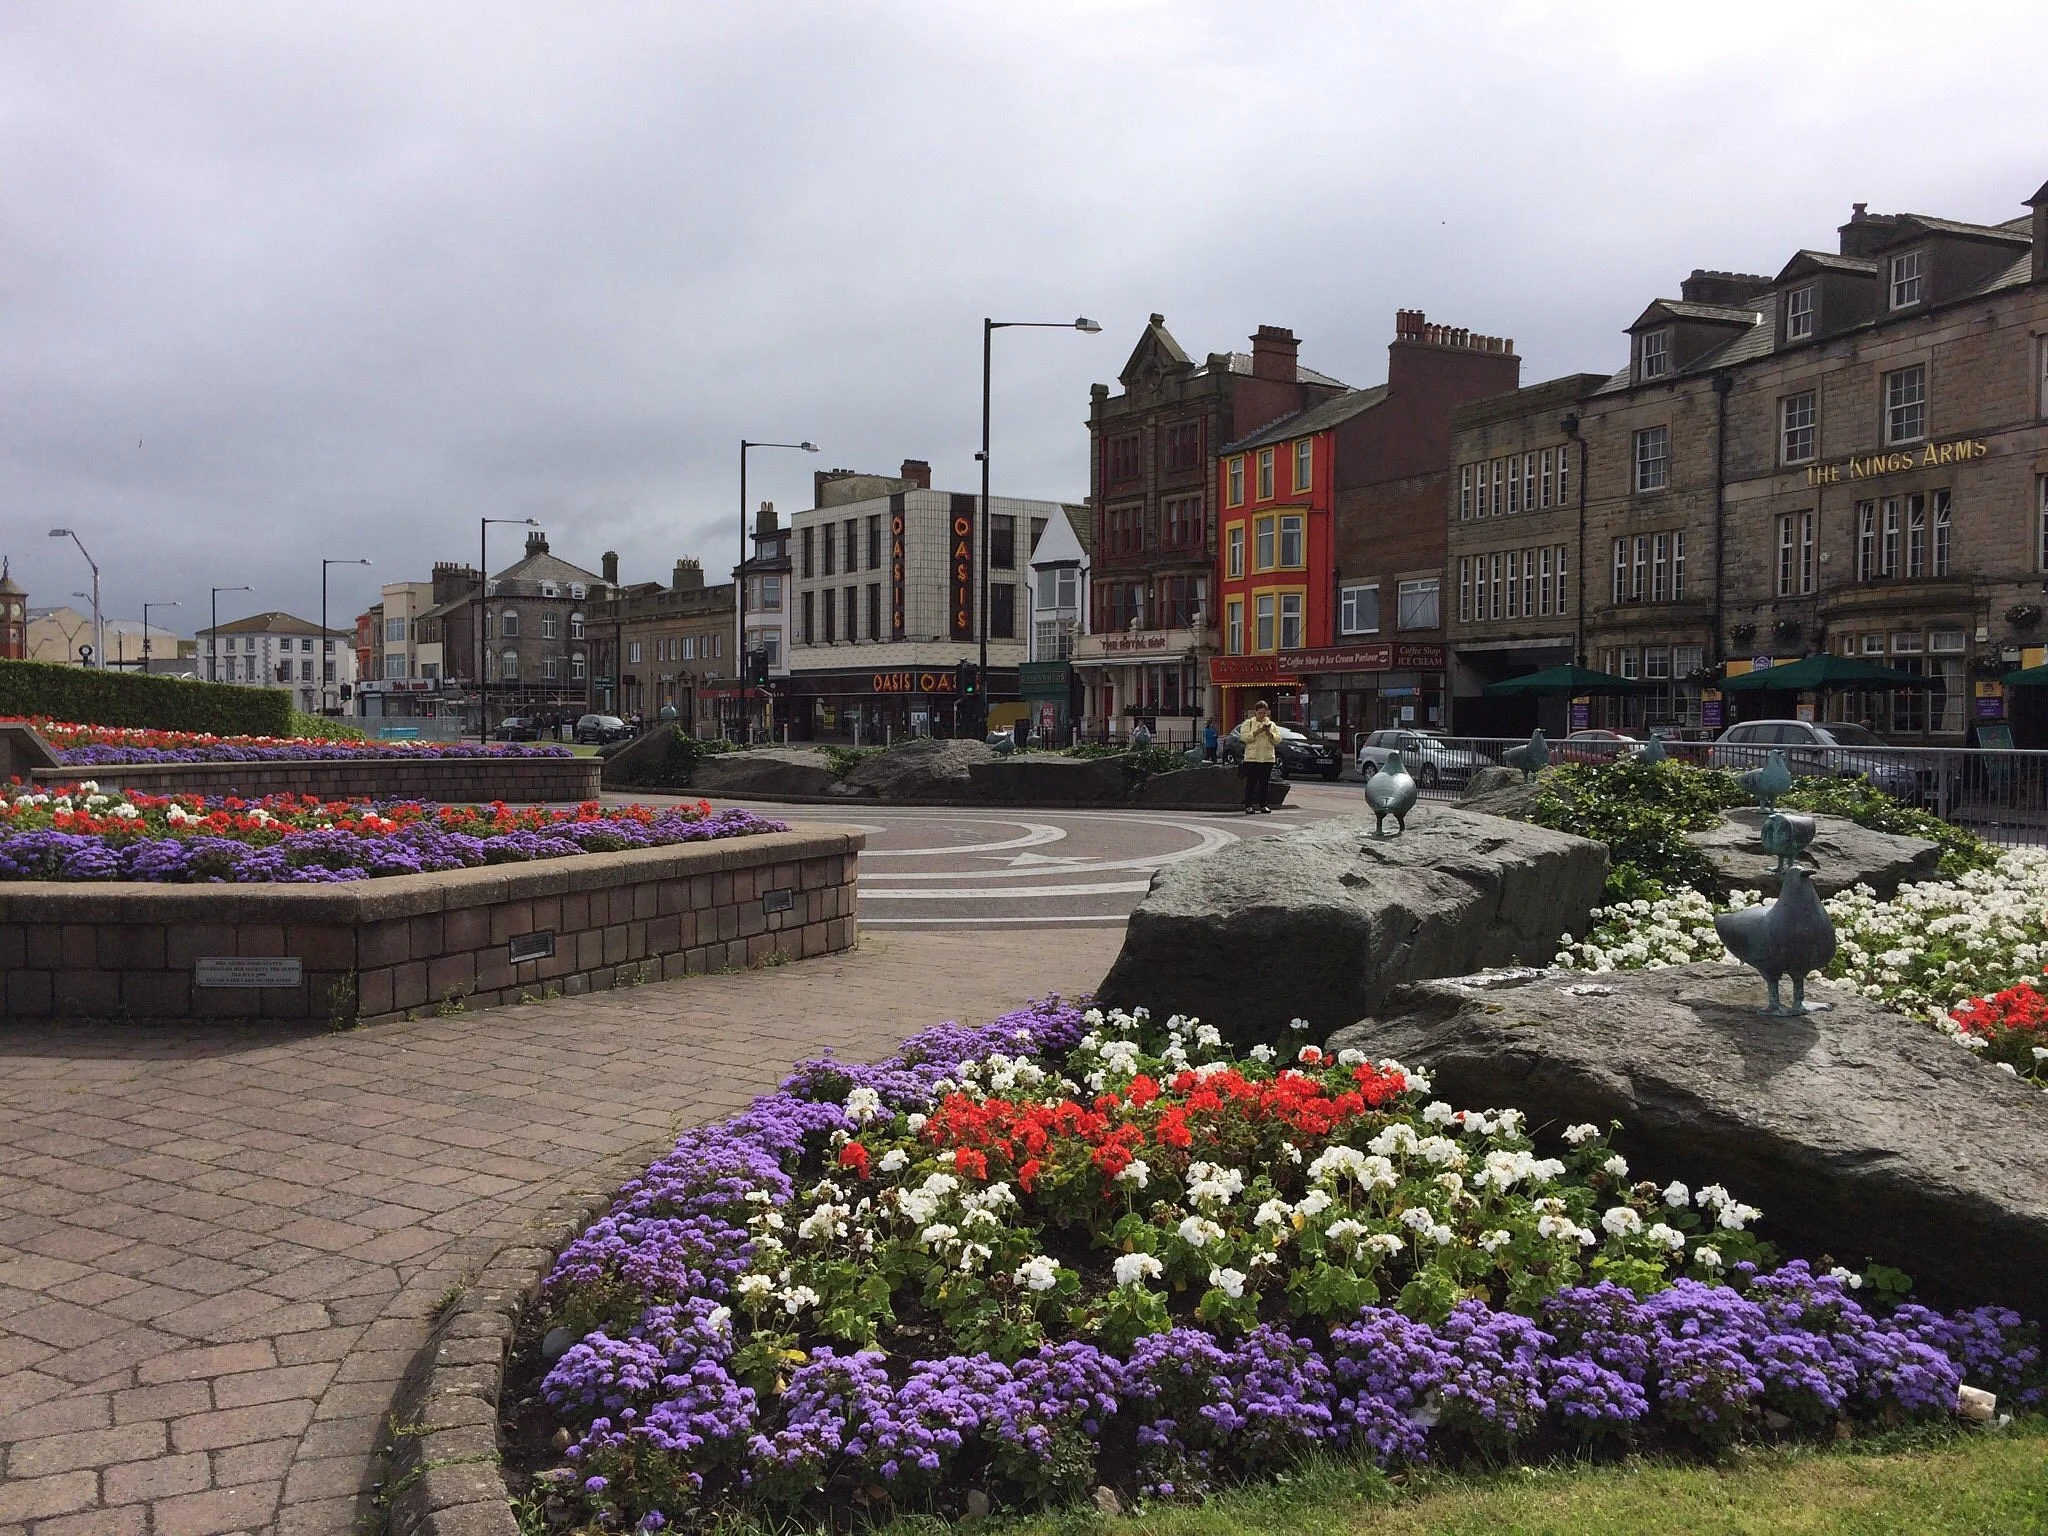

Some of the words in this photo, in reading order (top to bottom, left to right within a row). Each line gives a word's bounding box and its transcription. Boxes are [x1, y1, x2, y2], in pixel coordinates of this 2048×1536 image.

[1804, 463, 1841, 486] THE
[1849, 450, 1914, 479] KINGS
[1922, 437, 1987, 466] ARMS
[892, 515, 903, 630] OASIS
[954, 517, 970, 630] OASIS
[1101, 640, 1118, 650] THE
[1119, 639, 1147, 650] ROYAL
[1399, 646, 1422, 656] Coffee
[1422, 646, 1441, 656] Shop
[1286, 656, 1304, 668] Coffee
[1304, 656, 1319, 667] Shop
[1325, 655, 1334, 664] Ice
[1335, 654, 1354, 664] Cream
[1354, 652, 1379, 663] Parlour
[1398, 657, 1411, 666] ICE
[1412, 657, 1442, 666] CREAM
[873, 673, 911, 692] OASIS
